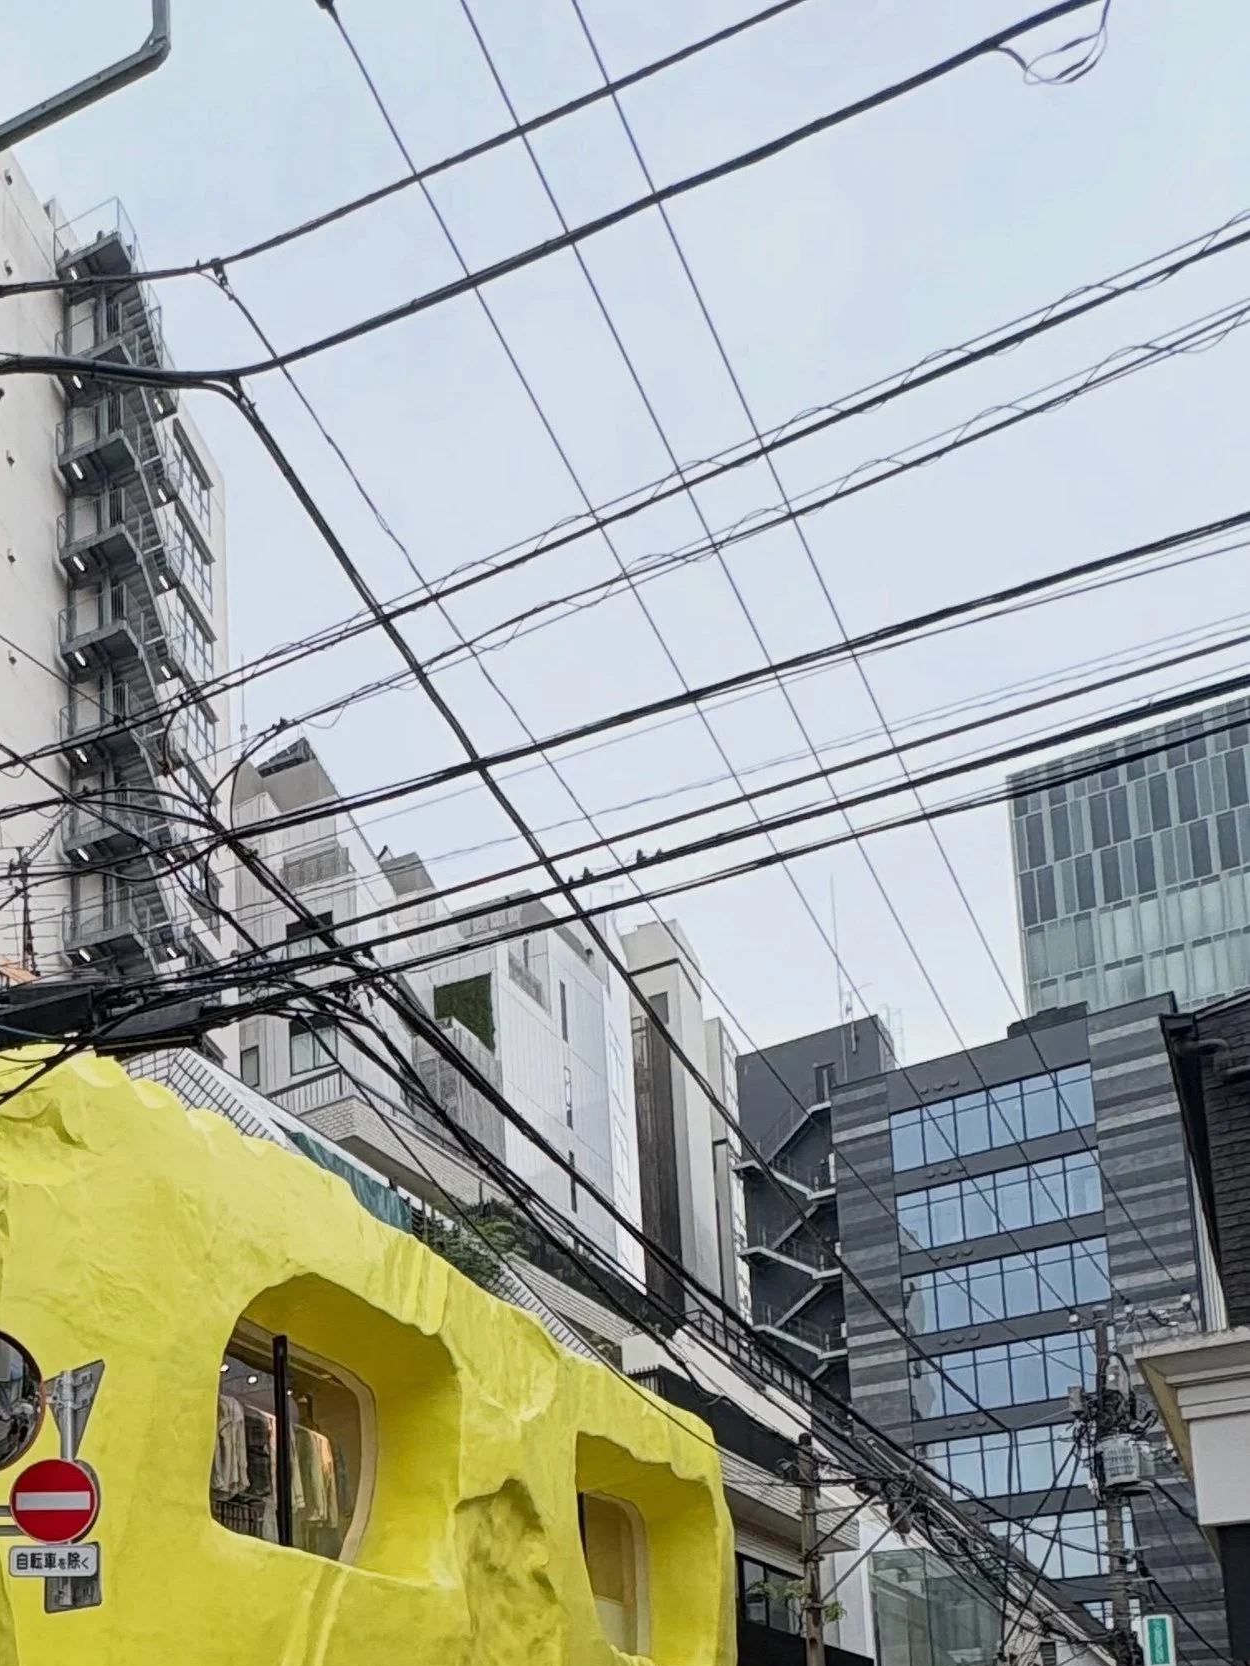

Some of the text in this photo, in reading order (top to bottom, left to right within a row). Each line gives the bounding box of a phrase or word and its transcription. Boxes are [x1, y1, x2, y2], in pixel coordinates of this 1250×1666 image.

[16, 1552, 90, 1571] 自転車を除く
